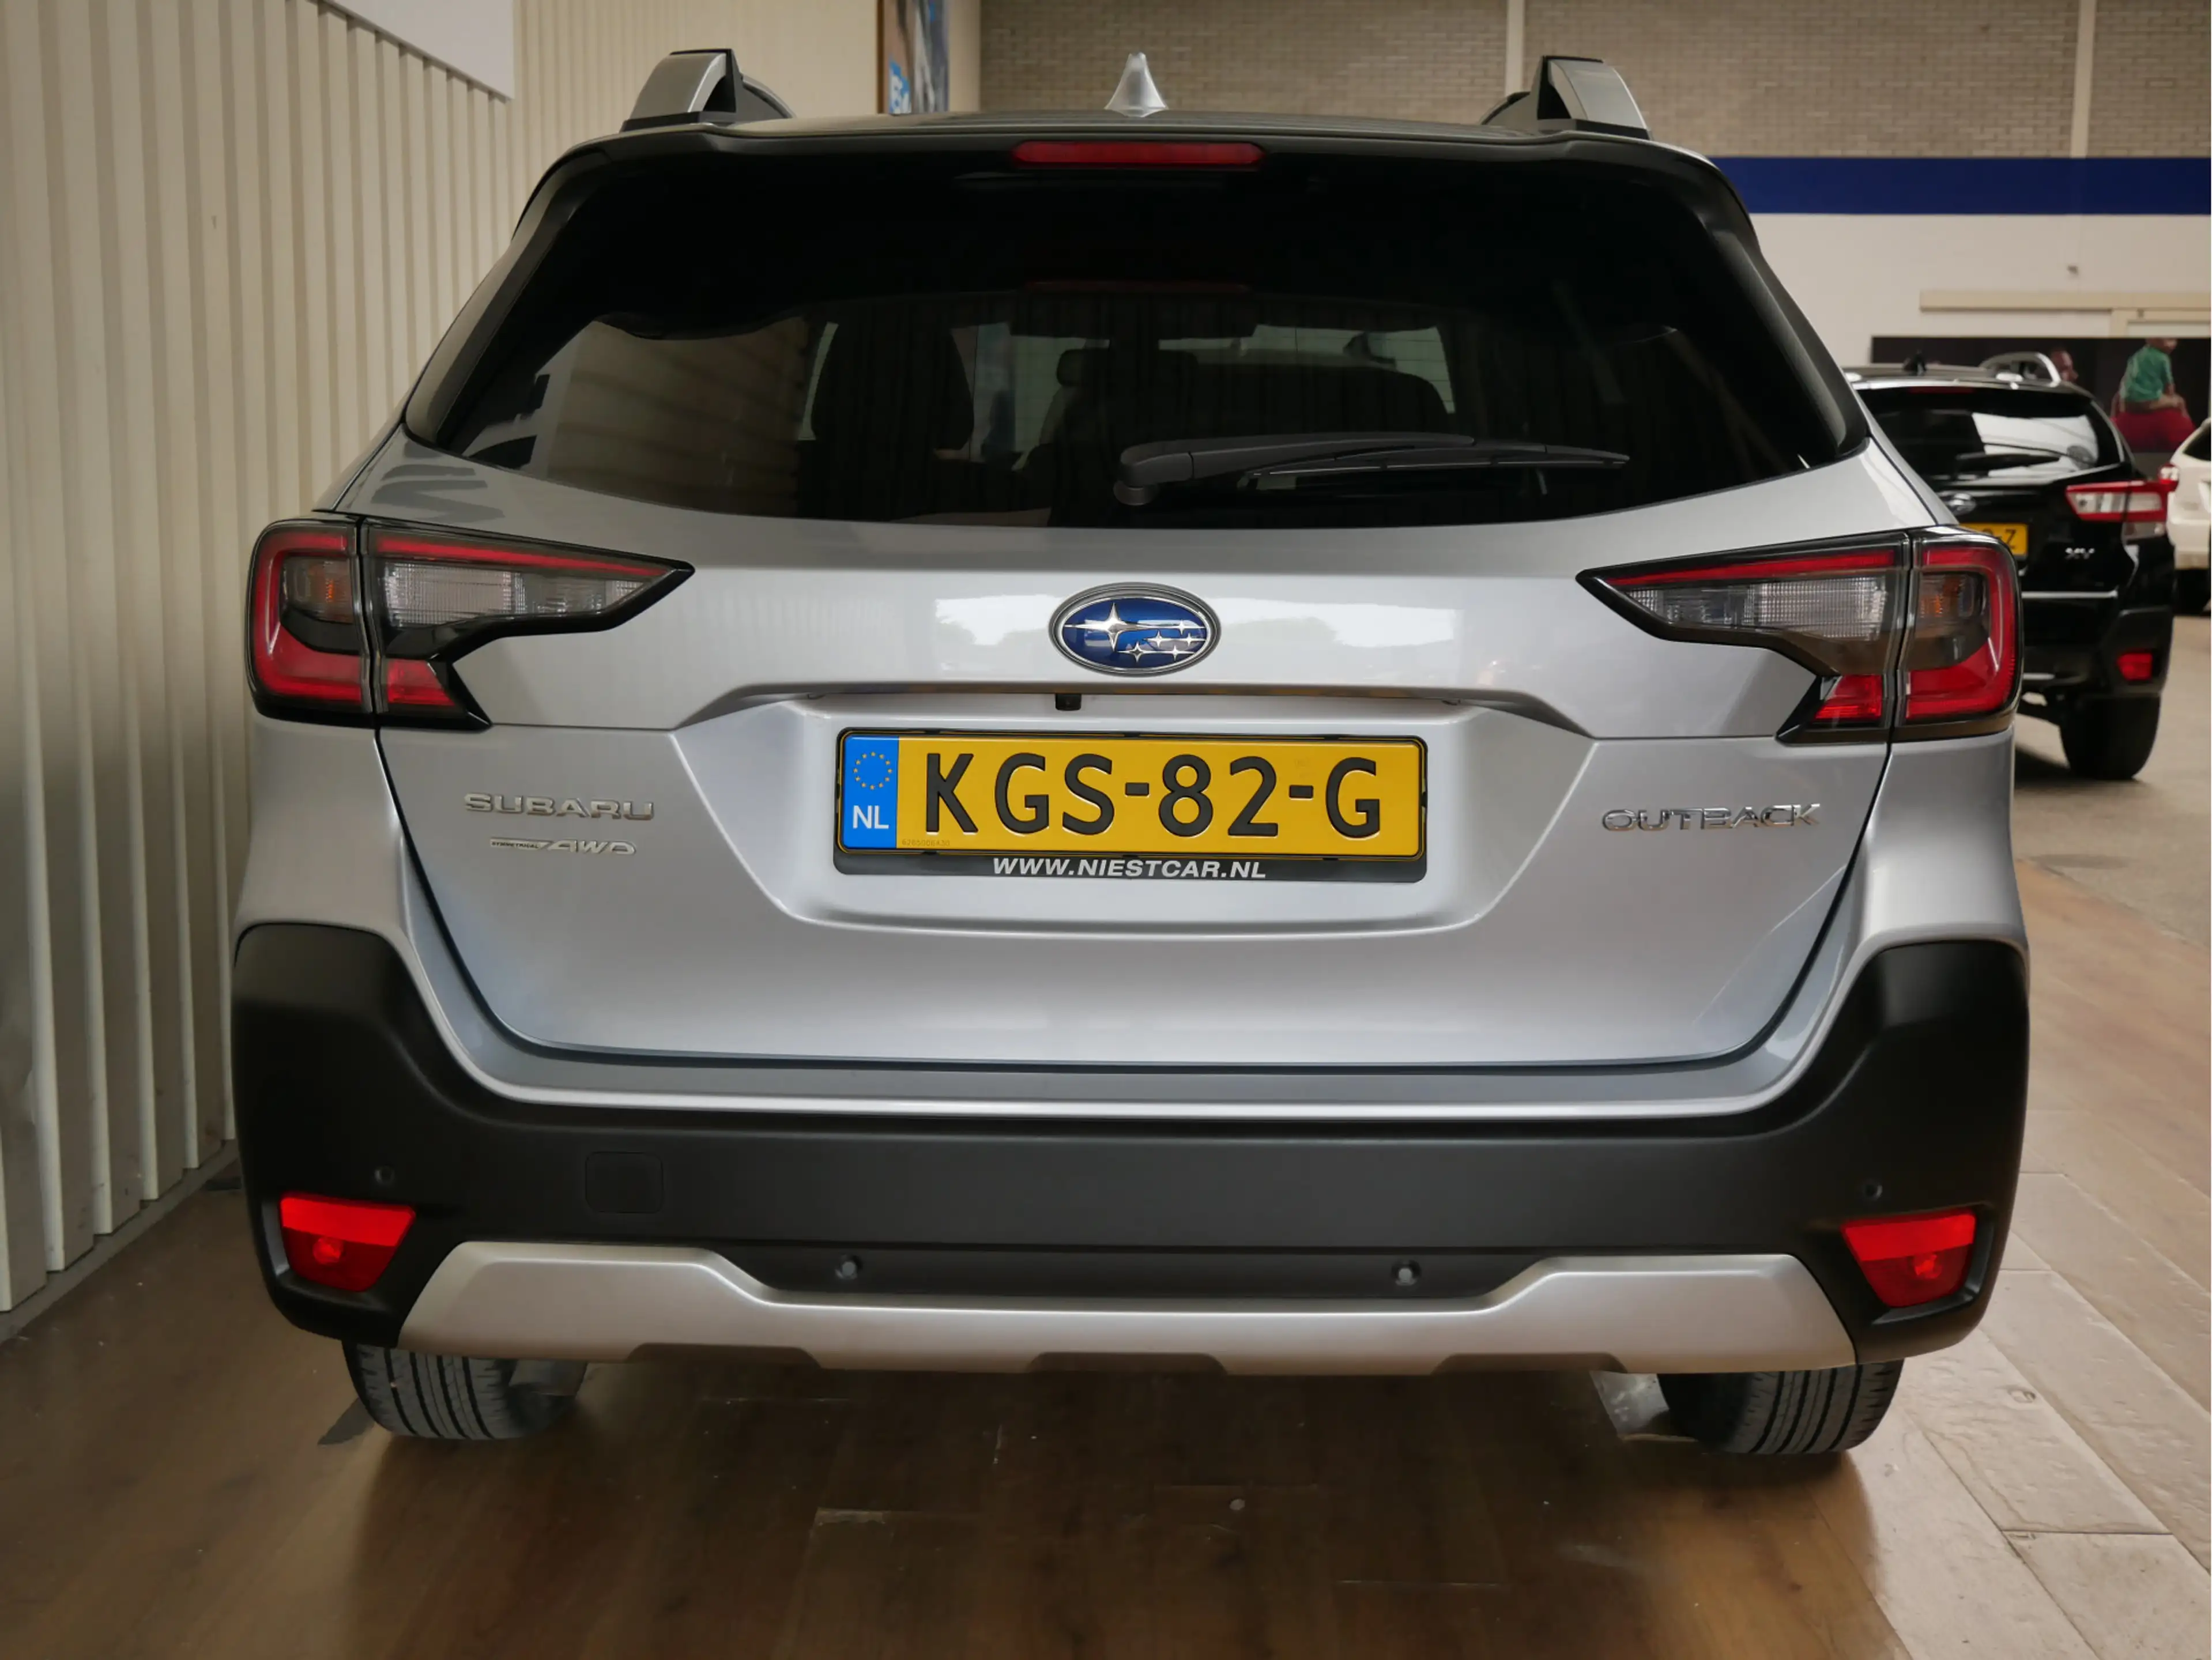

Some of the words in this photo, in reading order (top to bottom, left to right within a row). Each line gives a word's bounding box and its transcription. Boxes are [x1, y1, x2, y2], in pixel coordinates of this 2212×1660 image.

[464, 793, 654, 820] SUBARU
[925, 753, 1381, 838] KGS-82-G
[852, 805, 889, 829] NL
[1602, 803, 1821, 831] OUTBACK
[548, 839, 636, 855] AWD
[993, 857, 1267, 879] WWW.NIESTCAR.NL
